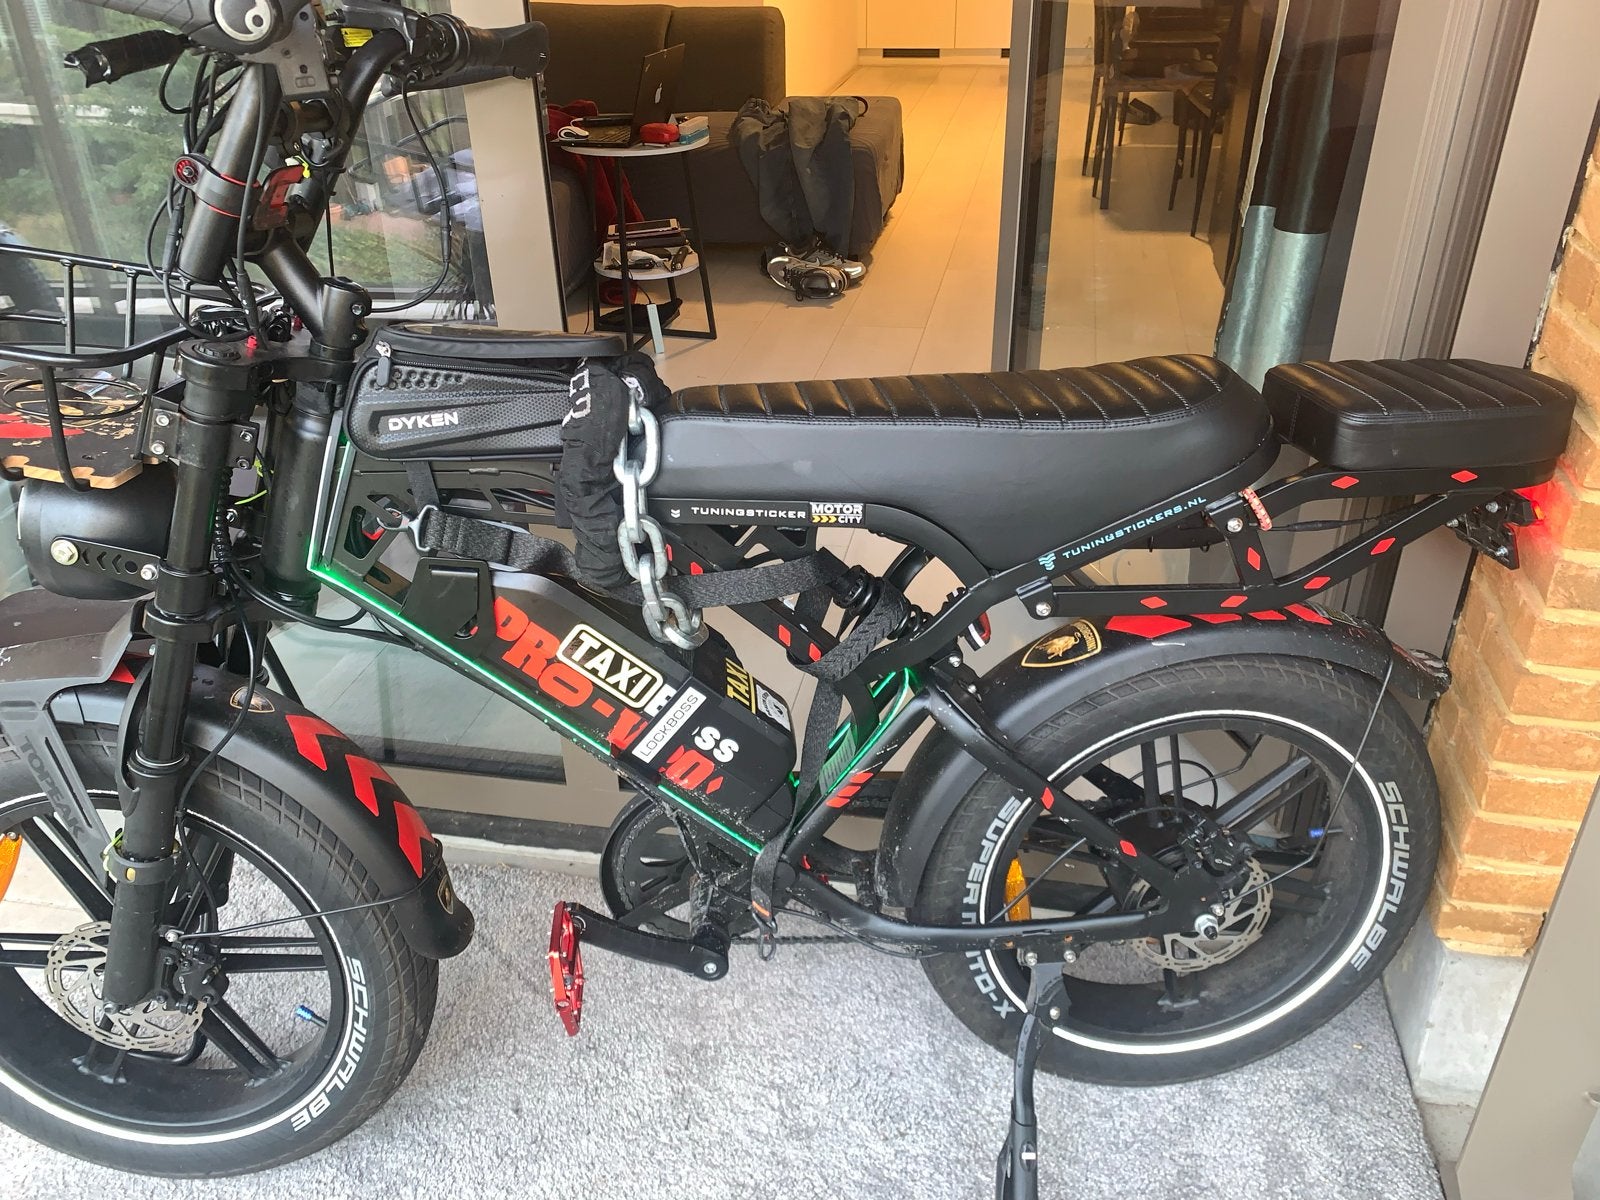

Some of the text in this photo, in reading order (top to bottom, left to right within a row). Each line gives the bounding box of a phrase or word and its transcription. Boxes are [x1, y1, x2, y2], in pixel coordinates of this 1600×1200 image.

[387, 411, 459, 431] DYKEN
[691, 506, 806, 519] TUNINGSTICKER
[811, 503, 863, 514] MOTOR
[1062, 496, 1207, 559] TUNINGSTICKERS.NL
[571, 631, 654, 699] TAXI
[725, 657, 750, 706] TAXI
[640, 694, 699, 757] LOCKBOSS
[19, 735, 85, 839] TOPEAK
[962, 796, 1022, 904] SUPER
[1350, 780, 1410, 972] SCHWALBE
[290, 955, 369, 1132] SCHWALBE
